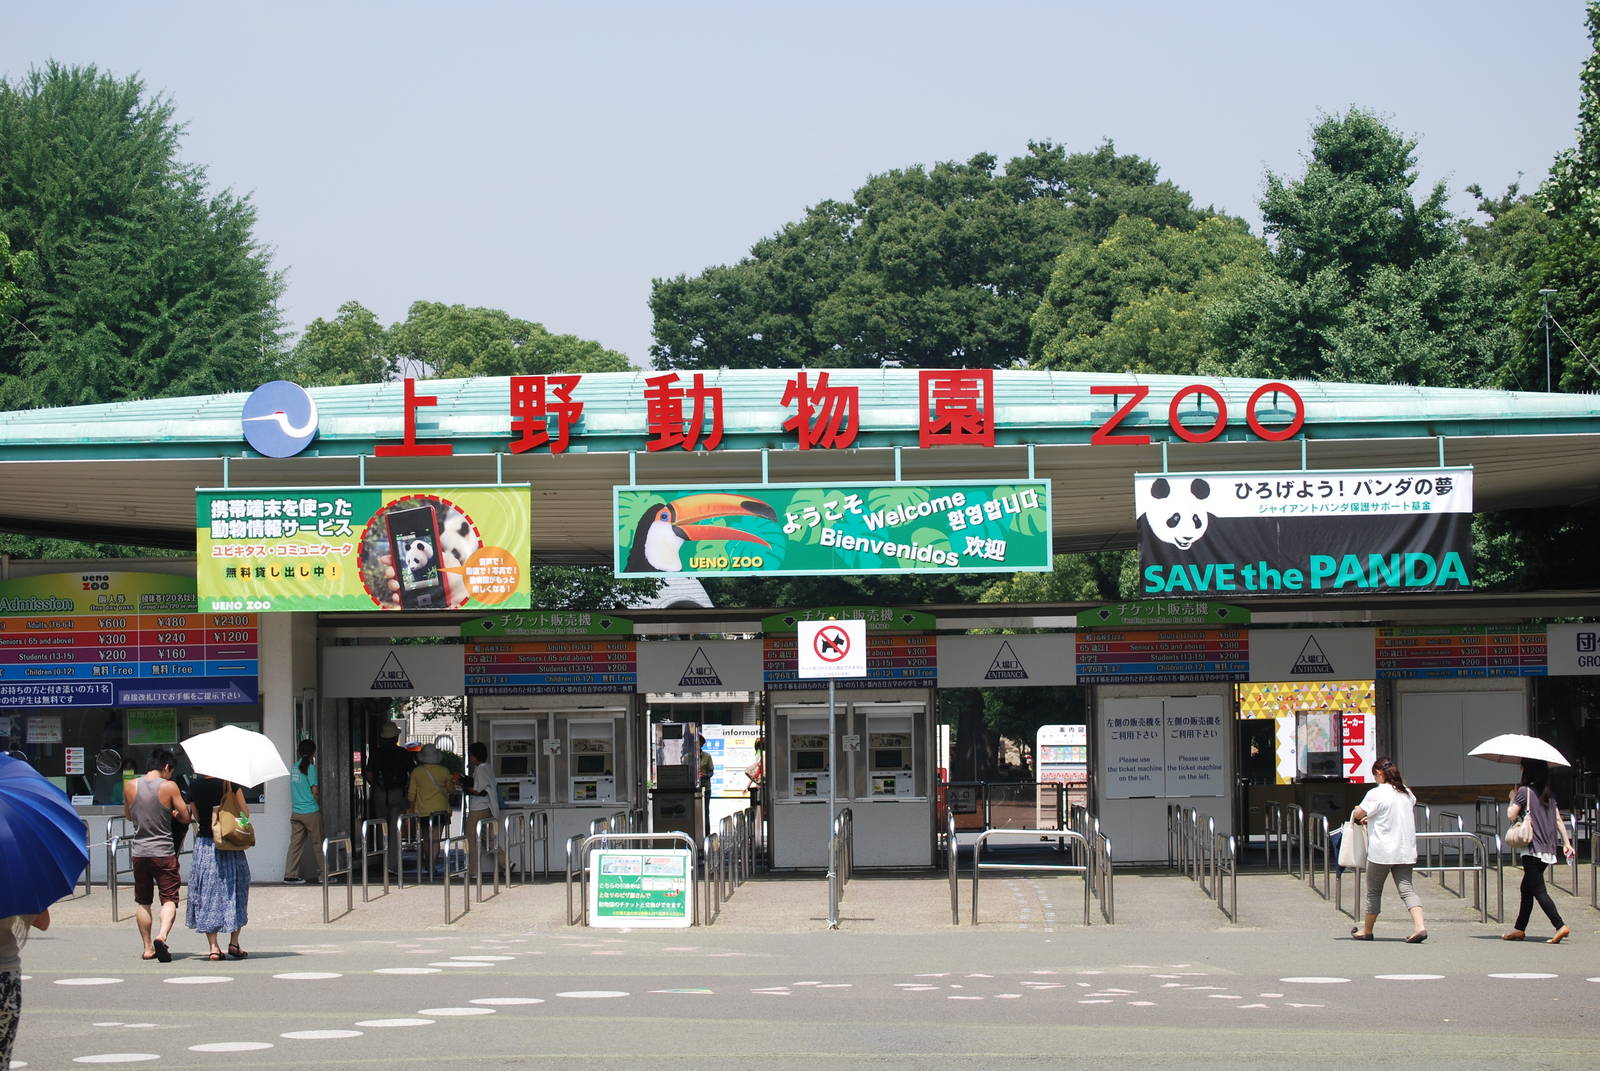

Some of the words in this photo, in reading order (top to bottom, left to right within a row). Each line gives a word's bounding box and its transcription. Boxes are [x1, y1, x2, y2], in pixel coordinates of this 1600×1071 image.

[375, 369, 995, 456] 上野動物園
[1090, 382, 1306, 447] ZOO
[211, 498, 353, 518] 携帯端末を使った
[782, 493, 865, 535] ようこそ
[863, 490, 967, 531] Welcome
[947, 488, 1040, 532] 환영합니다
[1258, 500, 1432, 514] ジャイアントパンダ保護サポート基金
[211, 518, 353, 539] 動物情報サービス
[211, 543, 353, 557] ユビキタス・コミュニケータ
[819, 528, 959, 567] Bienvenidos
[962, 535, 1008, 563] 欢迎
[689, 556, 728, 569] UENO
[732, 556, 763, 568] ZOO
[1145, 563, 1237, 593] SAVE
[1241, 561, 1305, 590] the
[1310, 552, 1471, 589] PANDA
[0, 596, 74, 612] Admission
[212, 601, 243, 610] UENO
[246, 601, 271, 610] ZOO
[1118, 604, 1209, 616] チケット販売機
[98, 618, 126, 628] ¥600
[158, 616, 186, 627] ¥480
[214, 616, 249, 626] ¥2400
[500, 614, 592, 626] チケット販売機
[98, 634, 126, 644] ¥300
[158, 632, 186, 643] ¥240
[214, 631, 249, 642] ¥1200
[1577, 632, 1600, 652] 団
[98, 650, 126, 660] ¥200
[158, 648, 186, 659] ¥160
[92, 666, 108, 676] 無料
[112, 666, 133, 676] Free
[152, 664, 169, 674] 無料
[172, 664, 193, 674] Free
[1294, 665, 1331, 673] ENTRANCE
